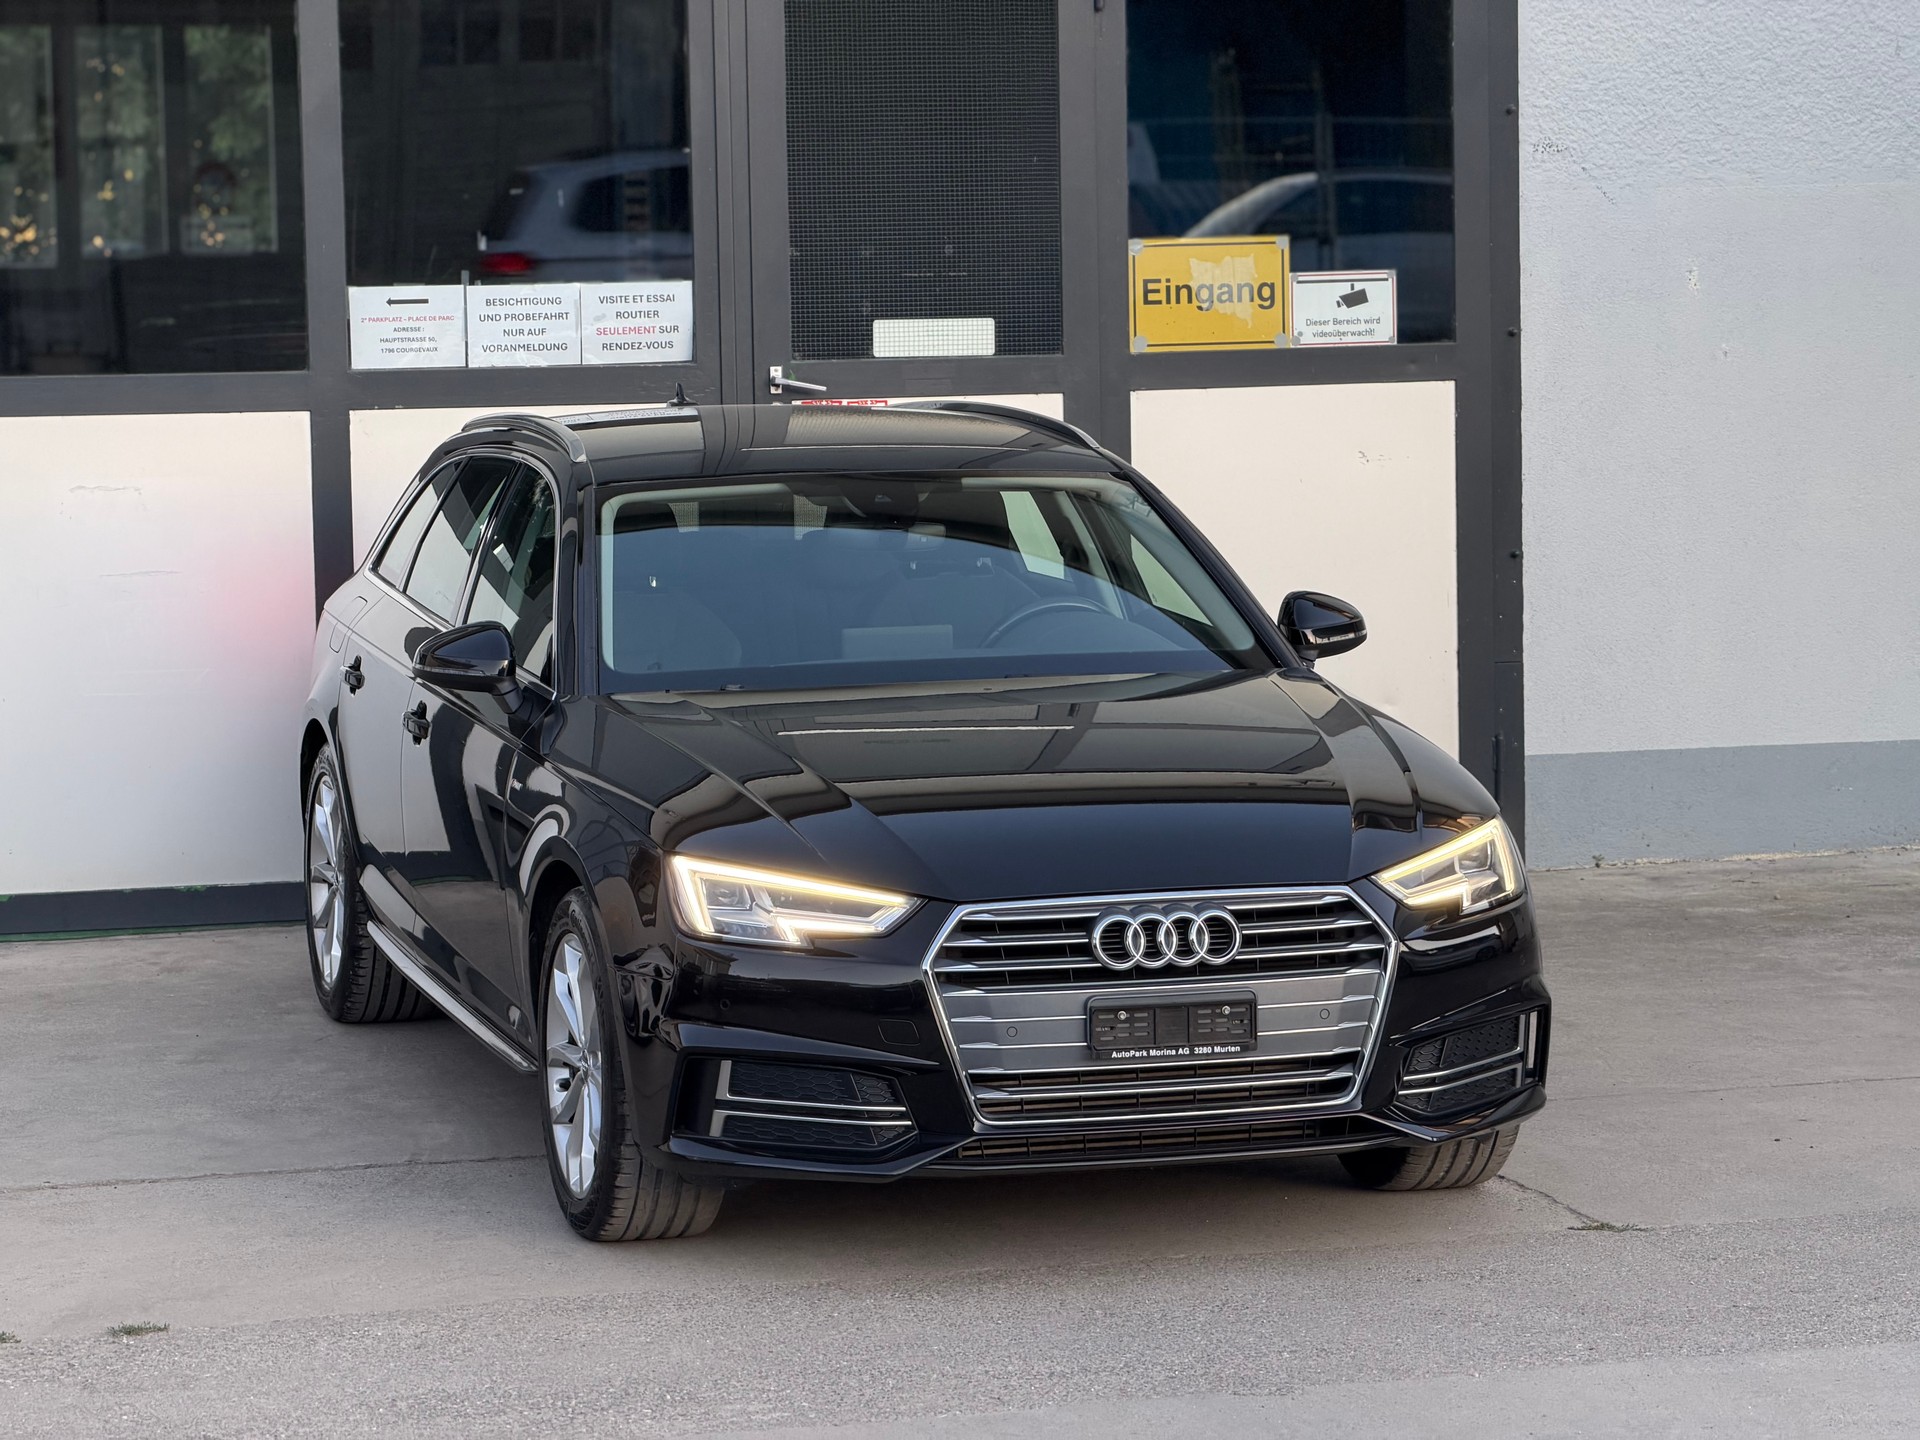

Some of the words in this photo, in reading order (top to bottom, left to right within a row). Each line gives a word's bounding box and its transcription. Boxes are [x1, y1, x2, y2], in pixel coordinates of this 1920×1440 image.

[598, 295, 630, 305] VISITE
[633, 295, 644, 304] ET
[646, 294, 675, 303] ESSAI
[1142, 277, 1276, 311] Eingang
[485, 296, 562, 307] BESICHTIGUNG
[479, 312, 501, 323] UND
[503, 311, 570, 322] PROBEFAHRT
[615, 309, 660, 320] ROUTIER
[1305, 317, 1331, 327] Dieser
[1332, 317, 1362, 326] Bereich
[1363, 316, 1381, 325] wird
[503, 327, 525, 337] NUR
[527, 327, 547, 337] AUF
[595, 325, 656, 336] SEULEMENT
[658, 325, 680, 335] SUR
[1312, 328, 1376, 338] videoüberwacht!
[481, 342, 568, 353] VORANMELDUNG
[601, 340, 674, 351] RENDEZ-VOUS
